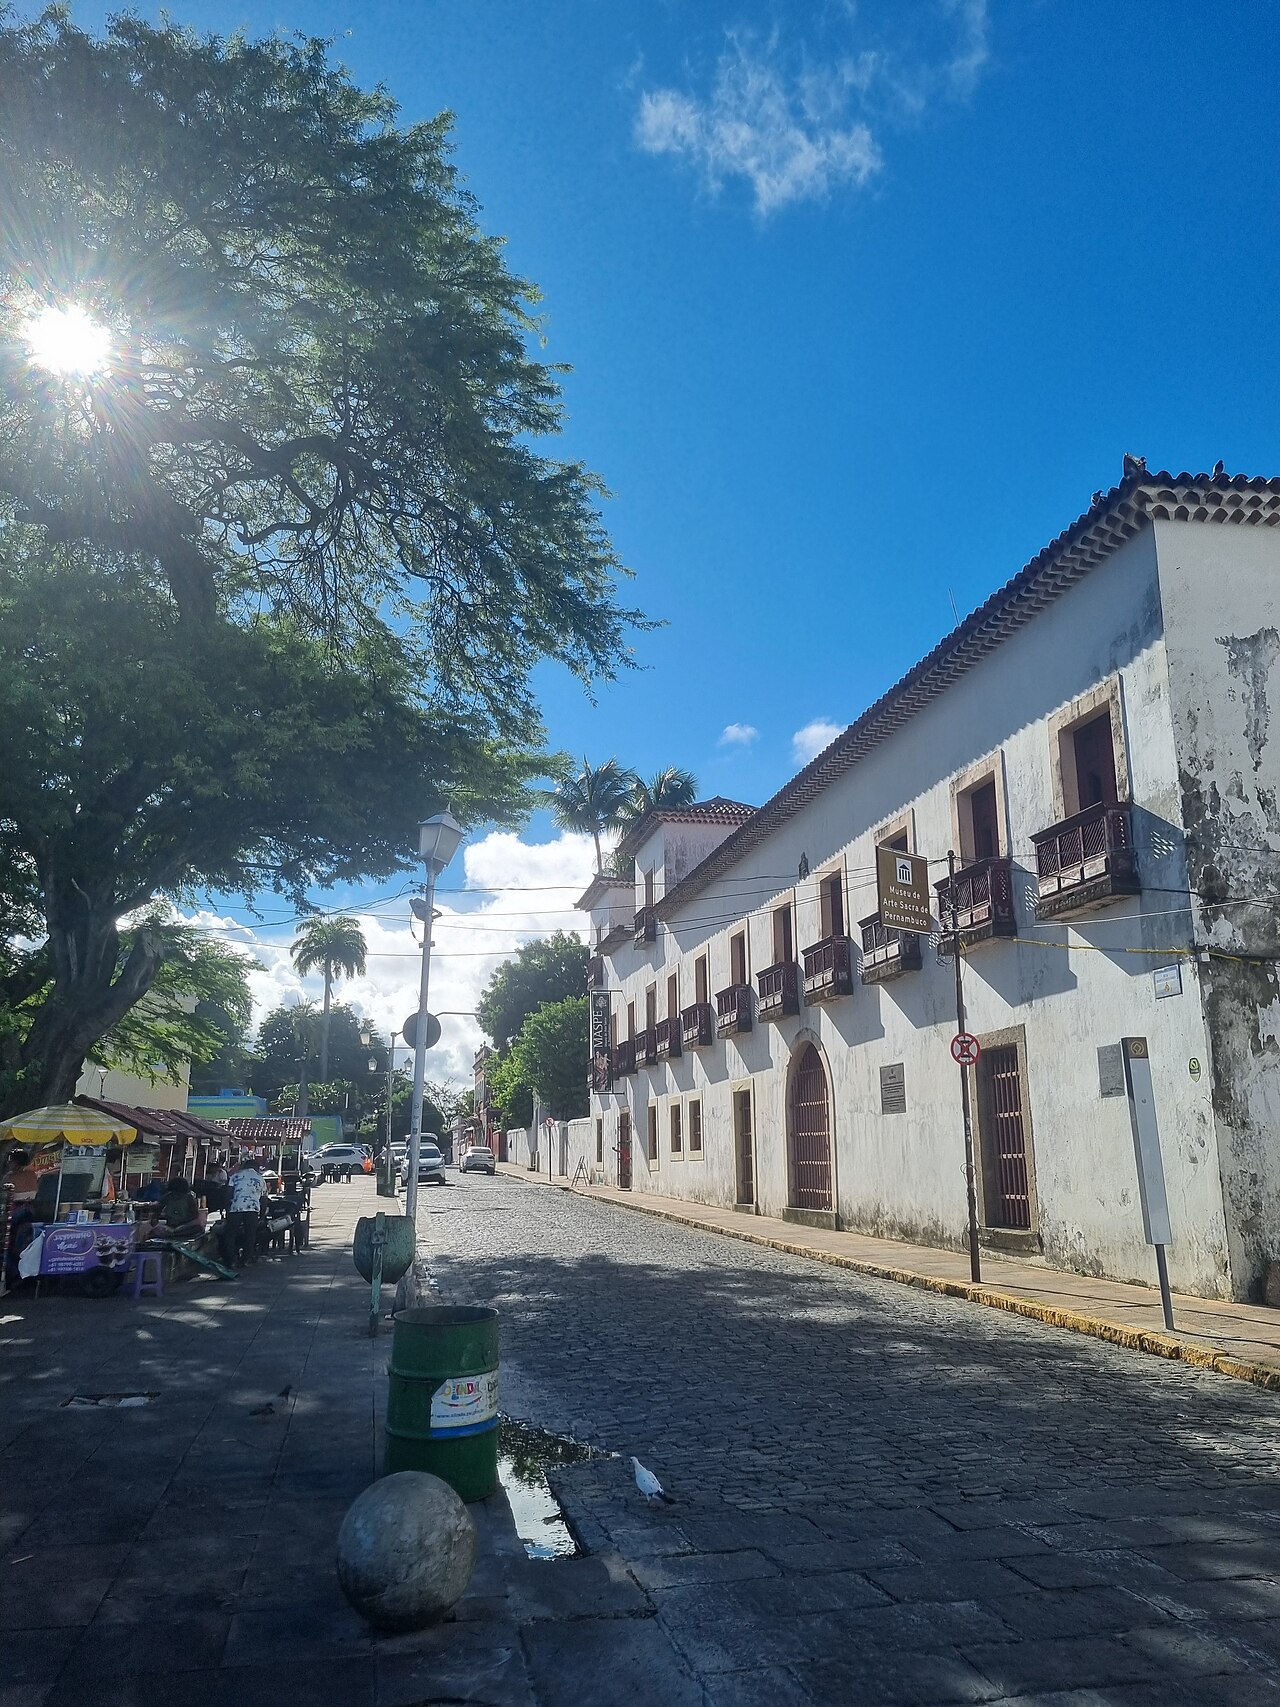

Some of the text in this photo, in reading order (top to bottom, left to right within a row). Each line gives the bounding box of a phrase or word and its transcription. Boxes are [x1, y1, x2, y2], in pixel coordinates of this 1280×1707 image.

[889, 886, 921, 899] Museu de
[883, 897, 929, 914] Arte Sacra de
[884, 910, 927, 926] Pernambuco
[593, 1010, 603, 1048] MASPE
